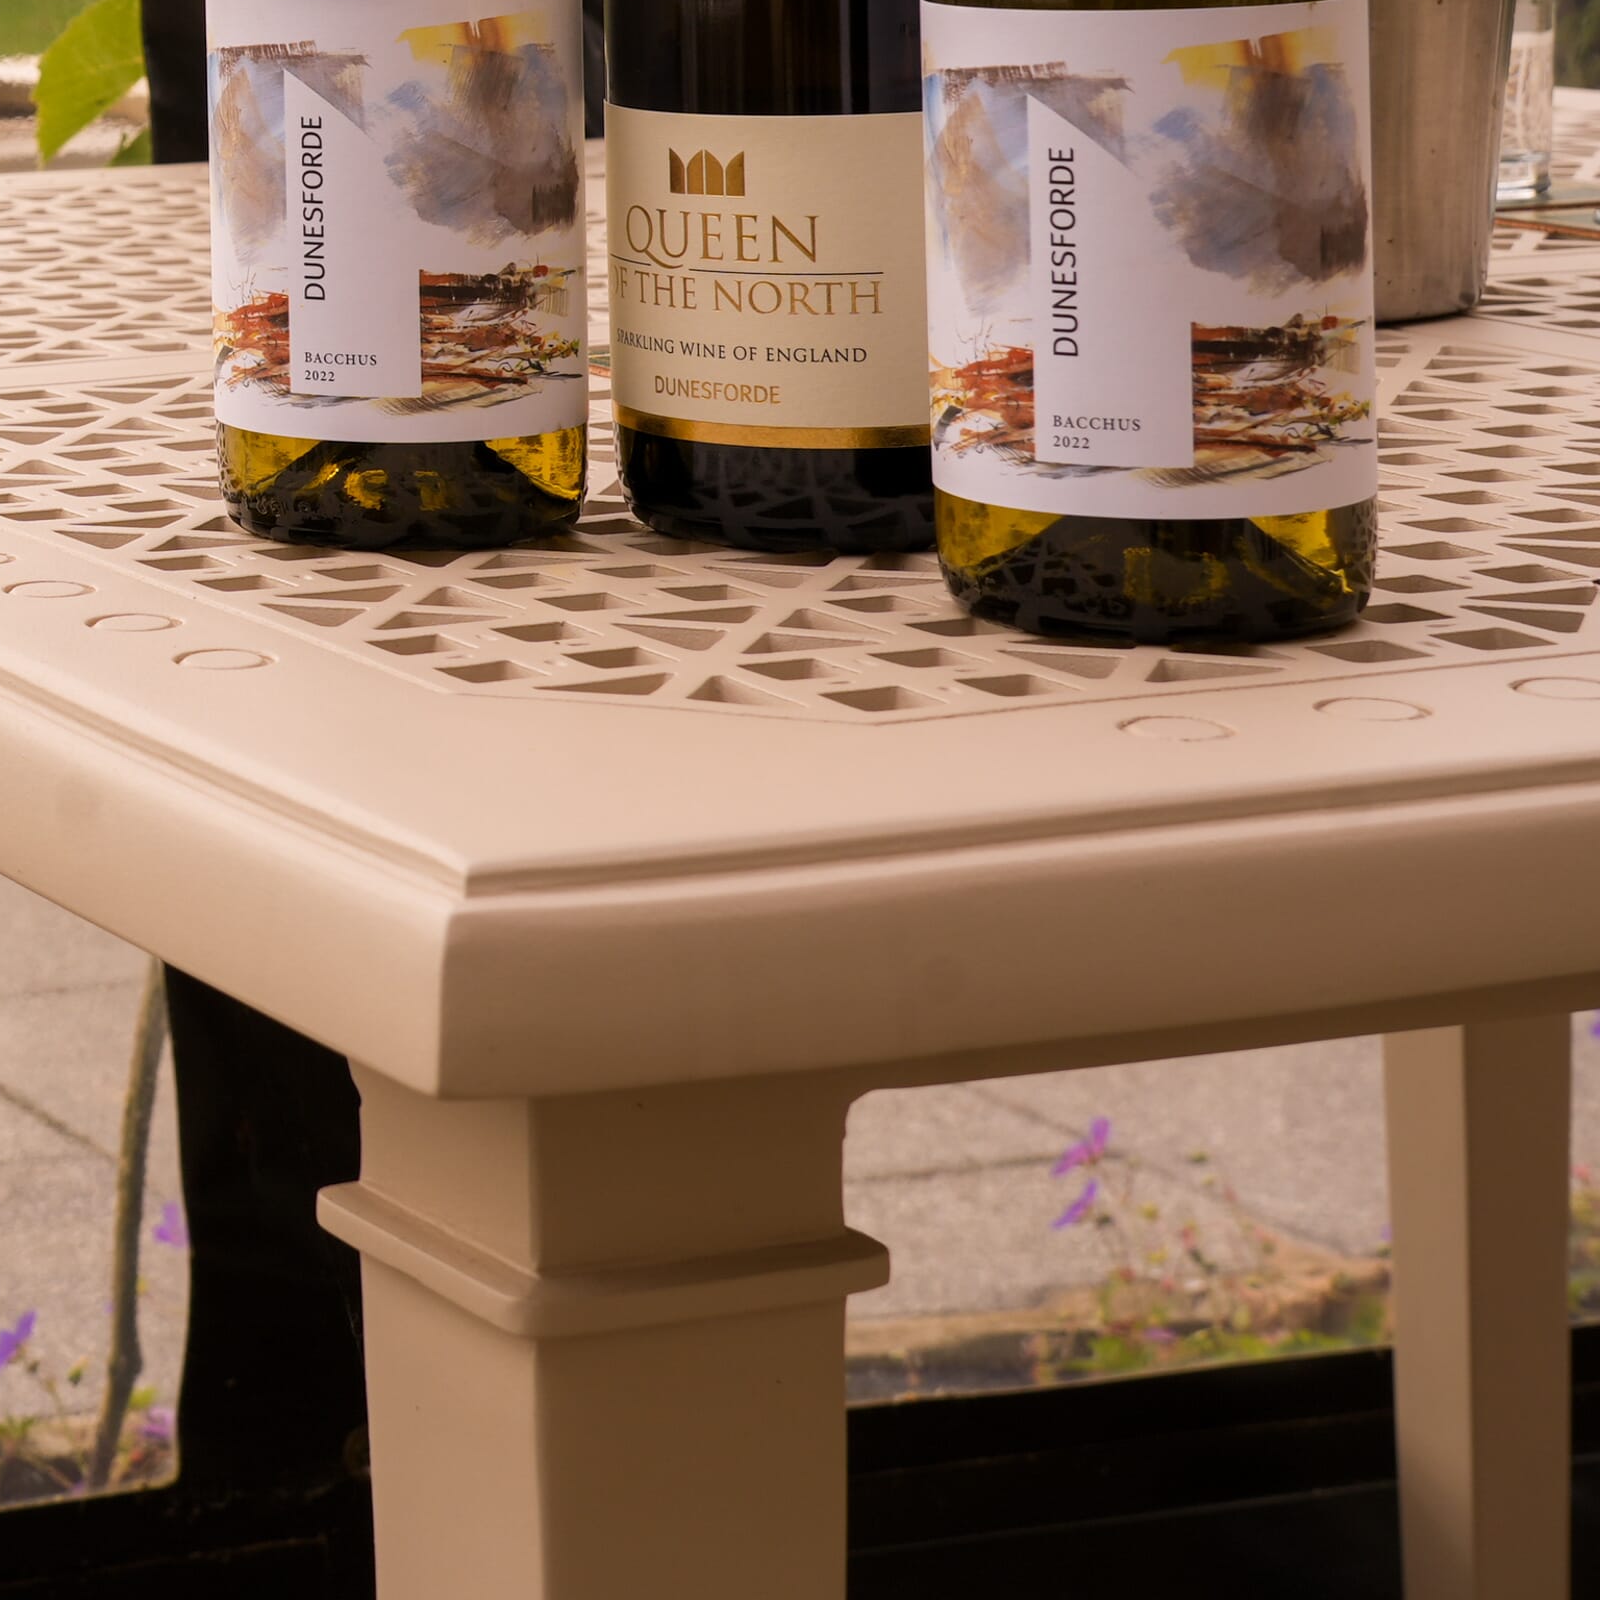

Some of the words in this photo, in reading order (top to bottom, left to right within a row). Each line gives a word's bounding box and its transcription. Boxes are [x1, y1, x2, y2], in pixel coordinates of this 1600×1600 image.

[300, 115, 326, 301] DUNESFORDE
[626, 204, 820, 269] QUEEN
[1048, 147, 1079, 357] DUNESFORDE
[634, 270, 697, 310] THE
[712, 279, 884, 316] NORTH
[304, 351, 378, 367] BACCHUS
[617, 327, 675, 355] SPARKLING
[680, 340, 726, 360] WINE
[733, 345, 759, 362] OF
[766, 347, 868, 364] ENGLAND
[304, 369, 336, 383] 2022
[654, 375, 782, 405] DUNESFORDE
[1052, 414, 1142, 432] BACCHUS
[1052, 434, 1091, 450] 2022
